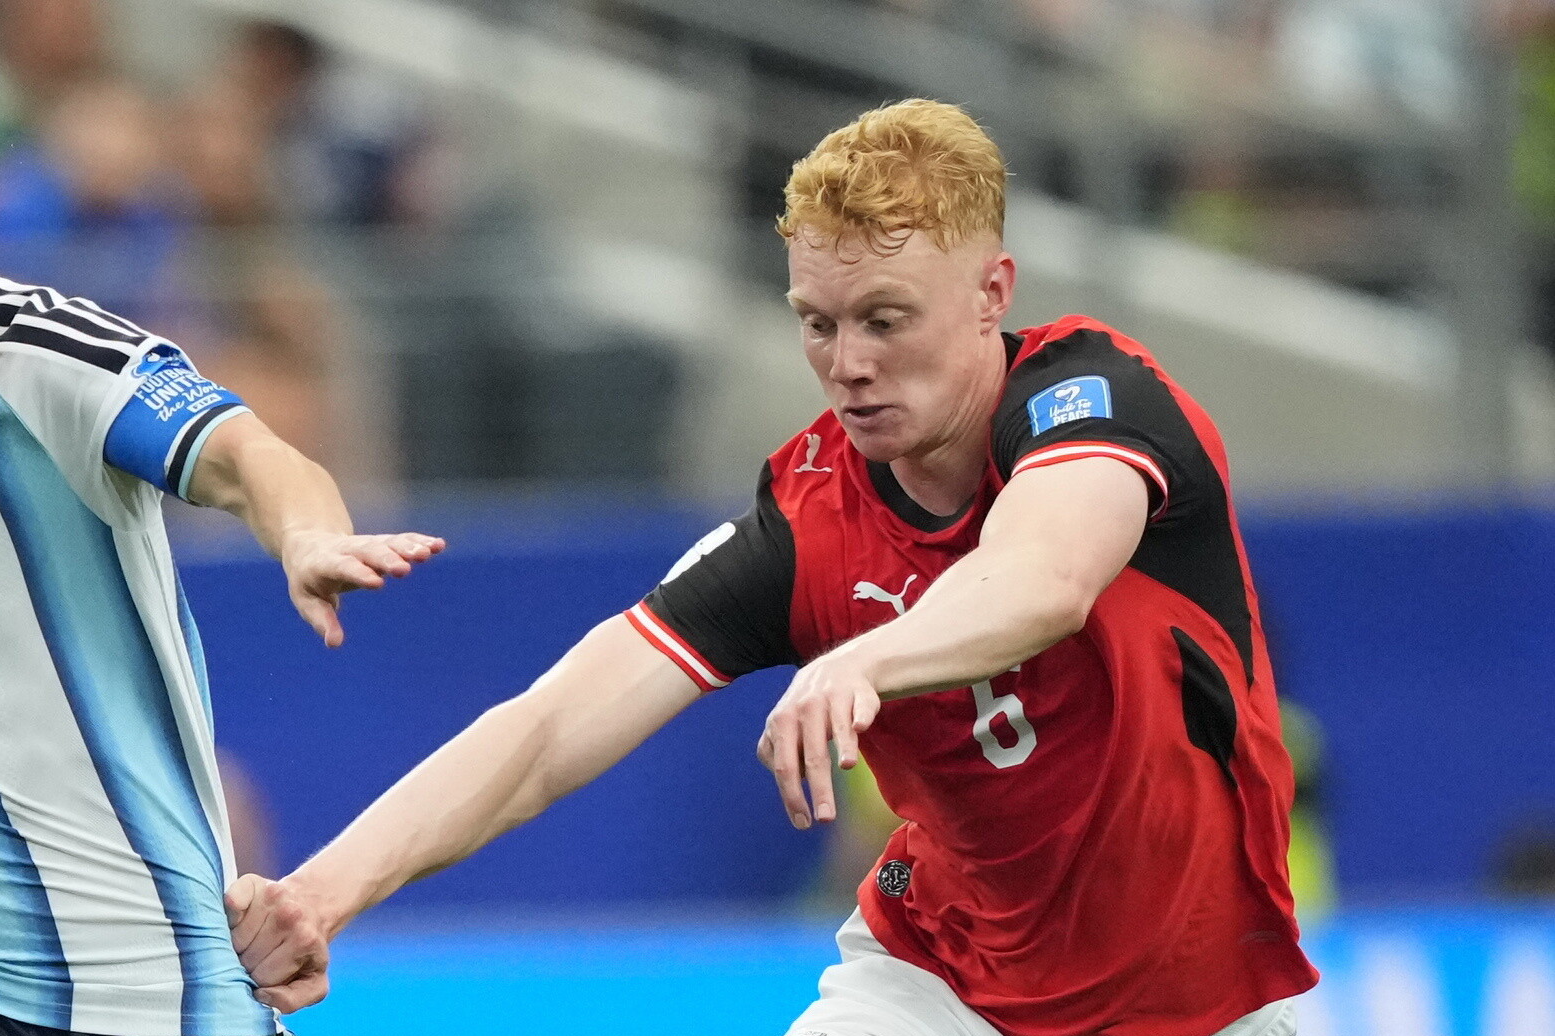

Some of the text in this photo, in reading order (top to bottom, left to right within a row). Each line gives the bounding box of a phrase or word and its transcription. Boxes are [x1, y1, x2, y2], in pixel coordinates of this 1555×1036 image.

[156, 400, 185, 421] the
[1049, 402, 1076, 418] Unite
[1052, 408, 1092, 427] PEACE
[973, 662, 1038, 769] 6
